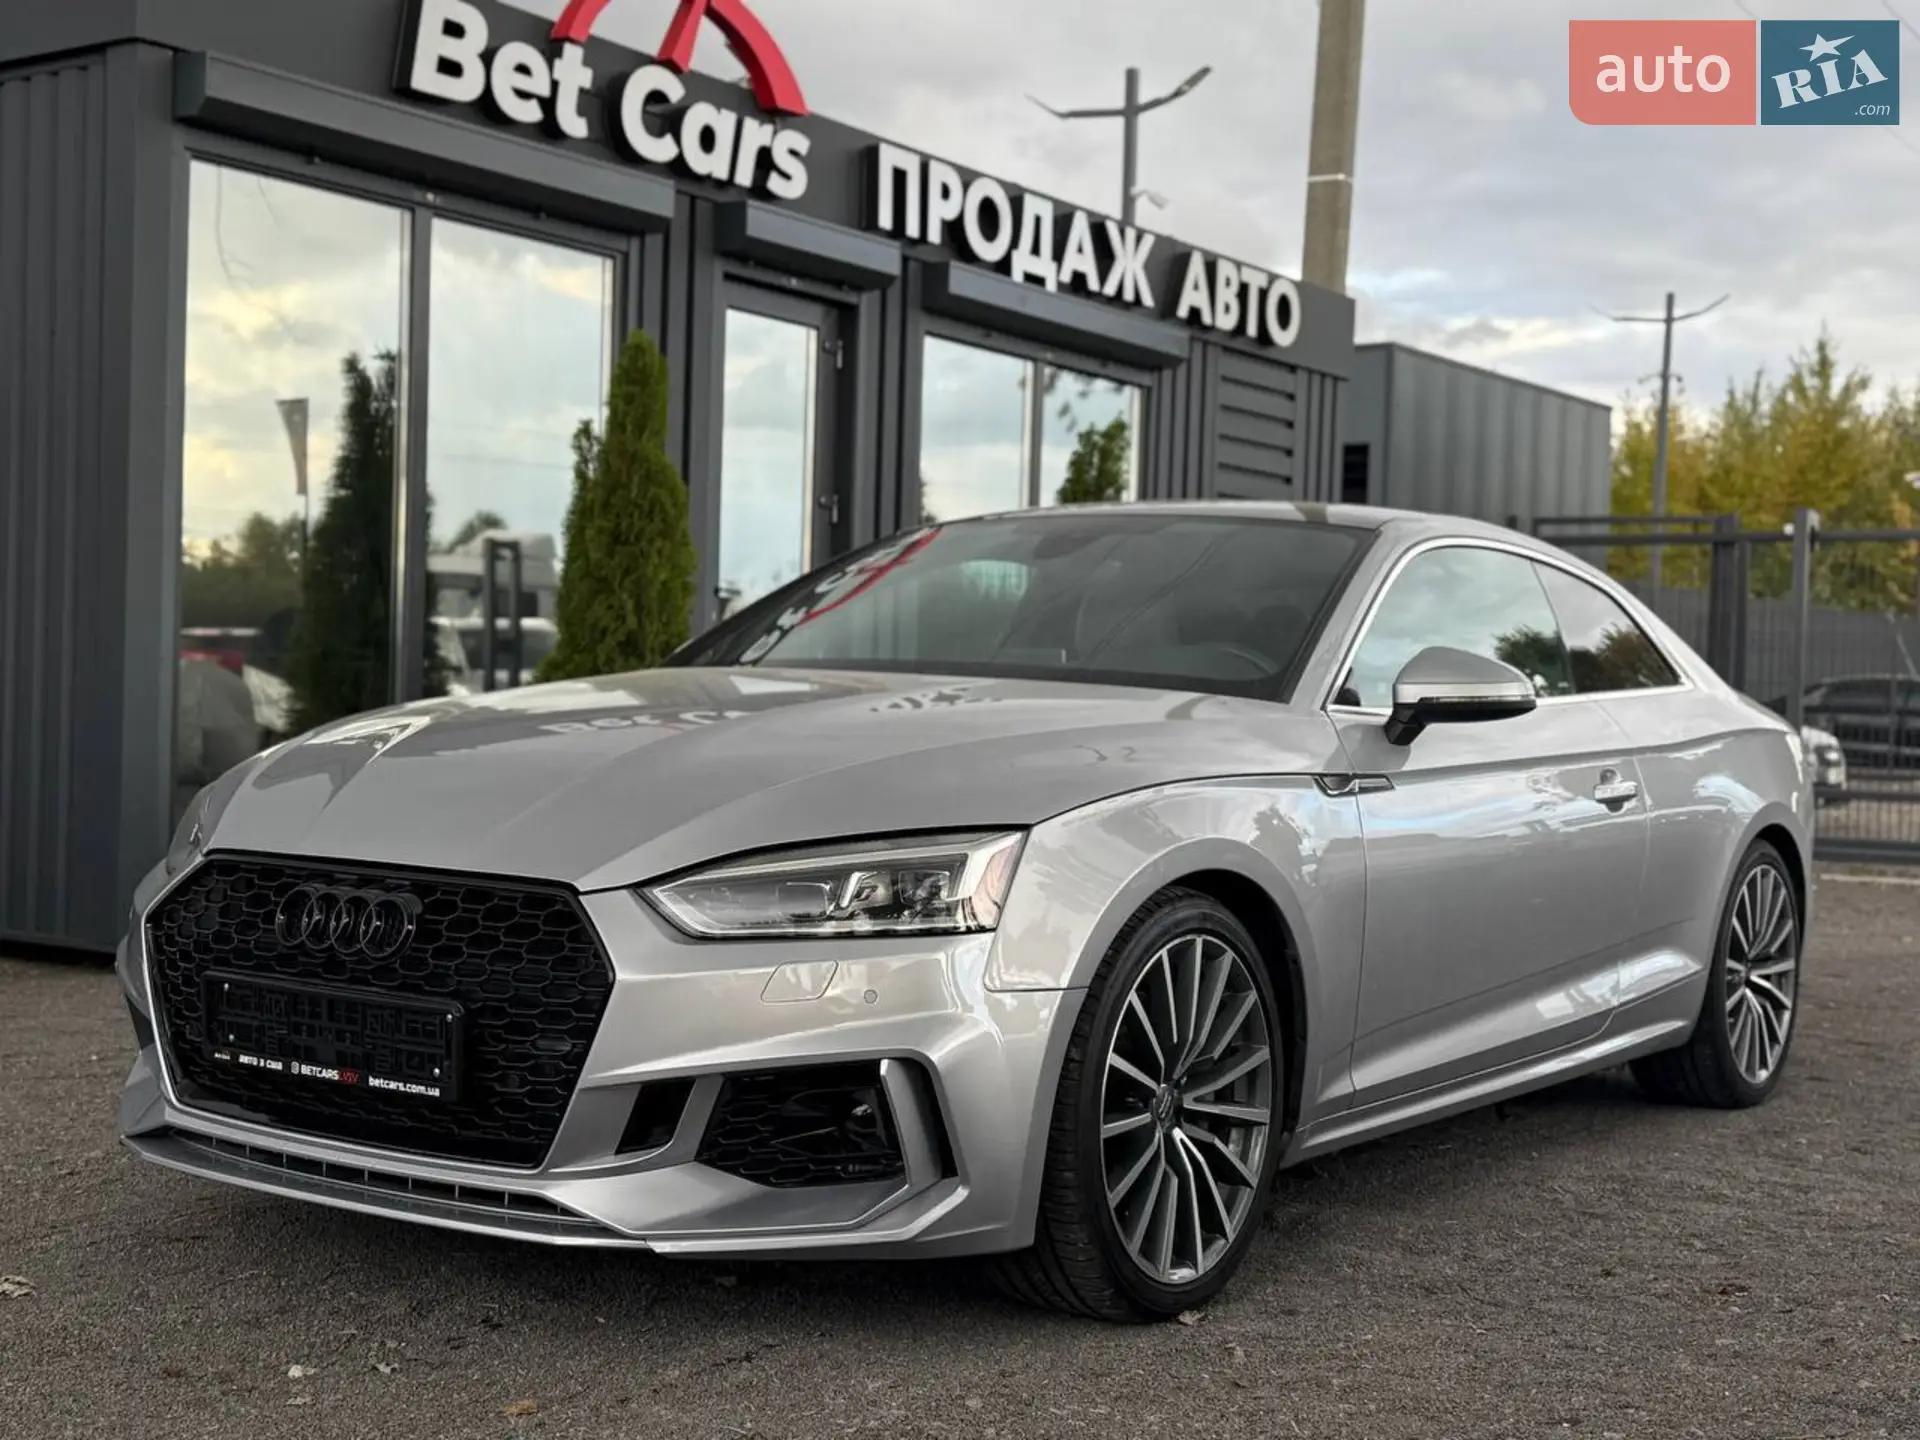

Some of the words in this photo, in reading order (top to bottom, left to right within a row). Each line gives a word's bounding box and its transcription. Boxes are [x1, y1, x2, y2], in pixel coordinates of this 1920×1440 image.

[411, 0, 593, 139] Bet
[621, 65, 810, 200] Cars
[878, 142, 1155, 309] ПРОДАЖ
[1176, 250, 1301, 348] АВТО
[368, 1075, 441, 1098] betcars.com.ua
